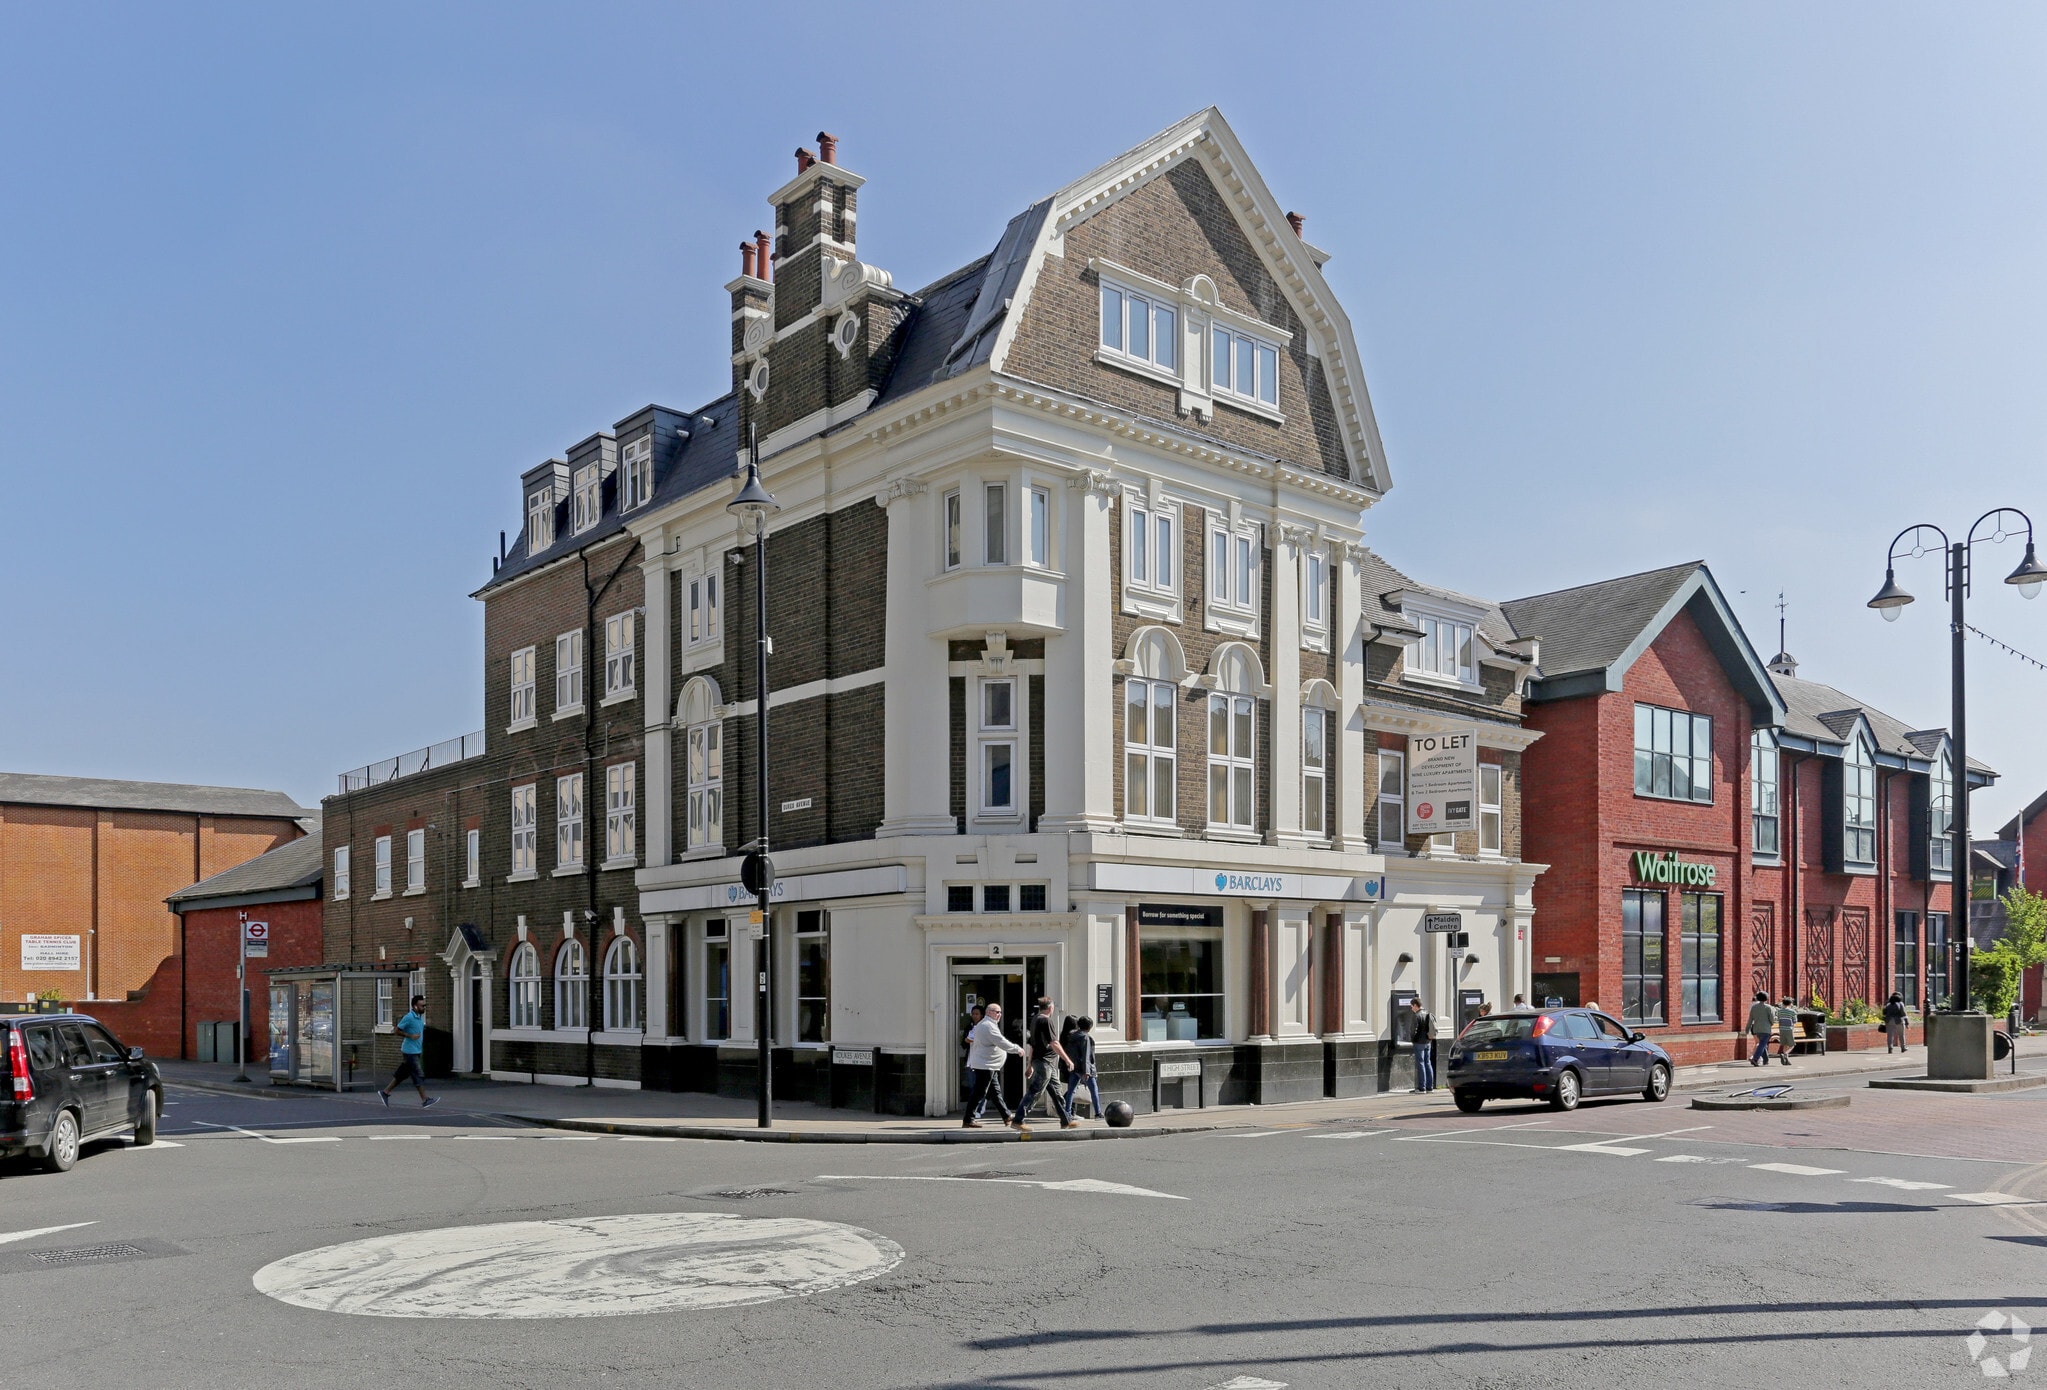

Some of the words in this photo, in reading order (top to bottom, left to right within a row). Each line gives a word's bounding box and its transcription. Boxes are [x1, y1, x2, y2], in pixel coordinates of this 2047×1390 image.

[1415, 737, 1436, 751] TO
[1441, 735, 1469, 749] LET
[1421, 762, 1455, 770] DEVELOPMENT
[1635, 850, 1717, 886] Waitrose
[1229, 875, 1282, 891] BARCLAYS
[239, 911, 248, 921] H
[1159, 911, 1167, 919] for
[1167, 912, 1189, 920] something
[992, 946, 1000, 954] 2
[853, 1052, 872, 1060] AVENUE
